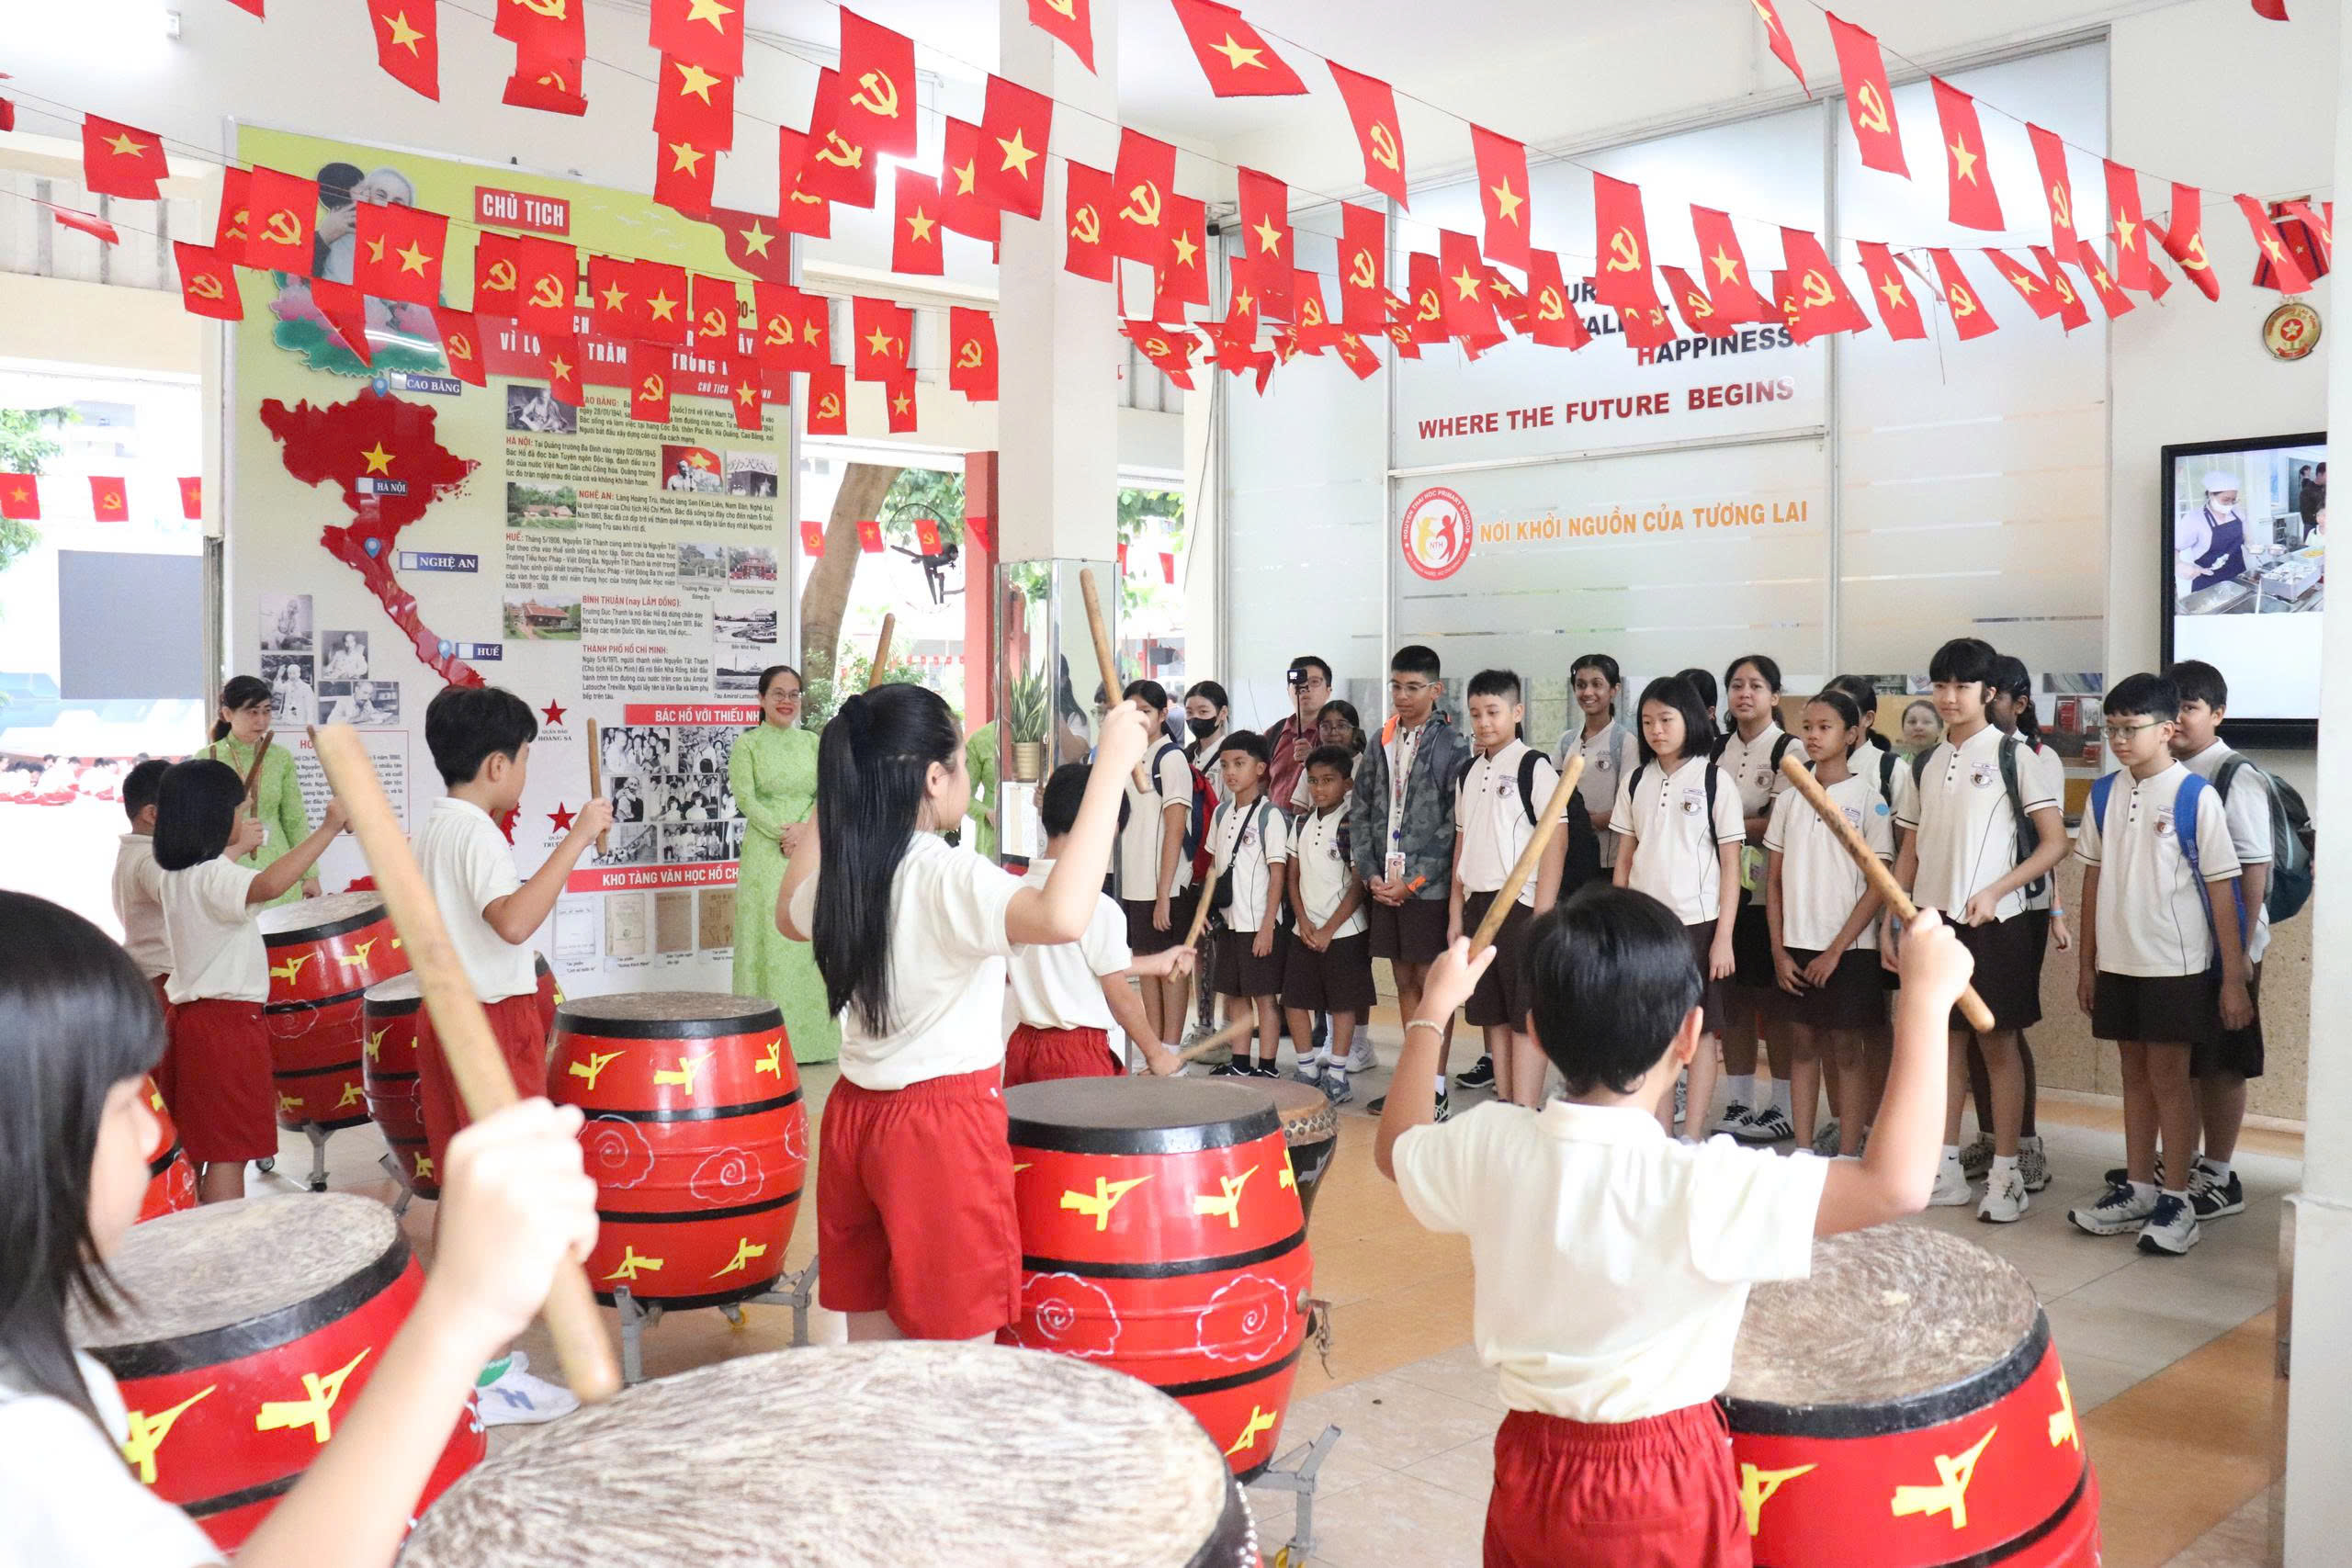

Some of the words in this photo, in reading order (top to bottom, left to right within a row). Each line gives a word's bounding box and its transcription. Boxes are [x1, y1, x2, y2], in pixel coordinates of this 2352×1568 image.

[482, 193, 518, 220] CHỦ
[525, 199, 564, 227] TỊCH
[500, 330, 516, 352] VÌ
[587, 341, 628, 365] TRĂM
[1637, 325, 1794, 367] HAPPINESS
[406, 378, 429, 389] CAO
[431, 379, 460, 393] BẰNG
[1418, 412, 1498, 440] WHERE
[1506, 405, 1555, 431] THE
[1566, 392, 1670, 423] FUTURE
[1687, 376, 1795, 411] BEGINS
[377, 480, 390, 491] HÀ
[390, 480, 406, 493] NỘI
[1480, 519, 1510, 544] NƠI
[1517, 511, 1561, 541] KHỞI
[1568, 505, 1637, 537] NGUỒN
[1643, 502, 1684, 533] CỦA
[1692, 502, 1765, 529] TƯƠNG
[1772, 501, 1808, 524] LAI
[420, 556, 456, 570] NGHỆ
[458, 558, 476, 569] AN
[477, 645, 500, 657] HUẾ
[655, 707, 676, 722] BÁC
[678, 706, 693, 722] HỒ
[695, 707, 712, 722] VỚI
[714, 706, 743, 722] THIẾU
[746, 710, 760, 722] NH
[602, 874, 626, 886] KHO
[628, 870, 658, 885] TÀNG
[660, 868, 683, 883] VĂN
[684, 868, 706, 884] HỌC
[708, 863, 723, 880] HỒ
[725, 866, 739, 879] CH
